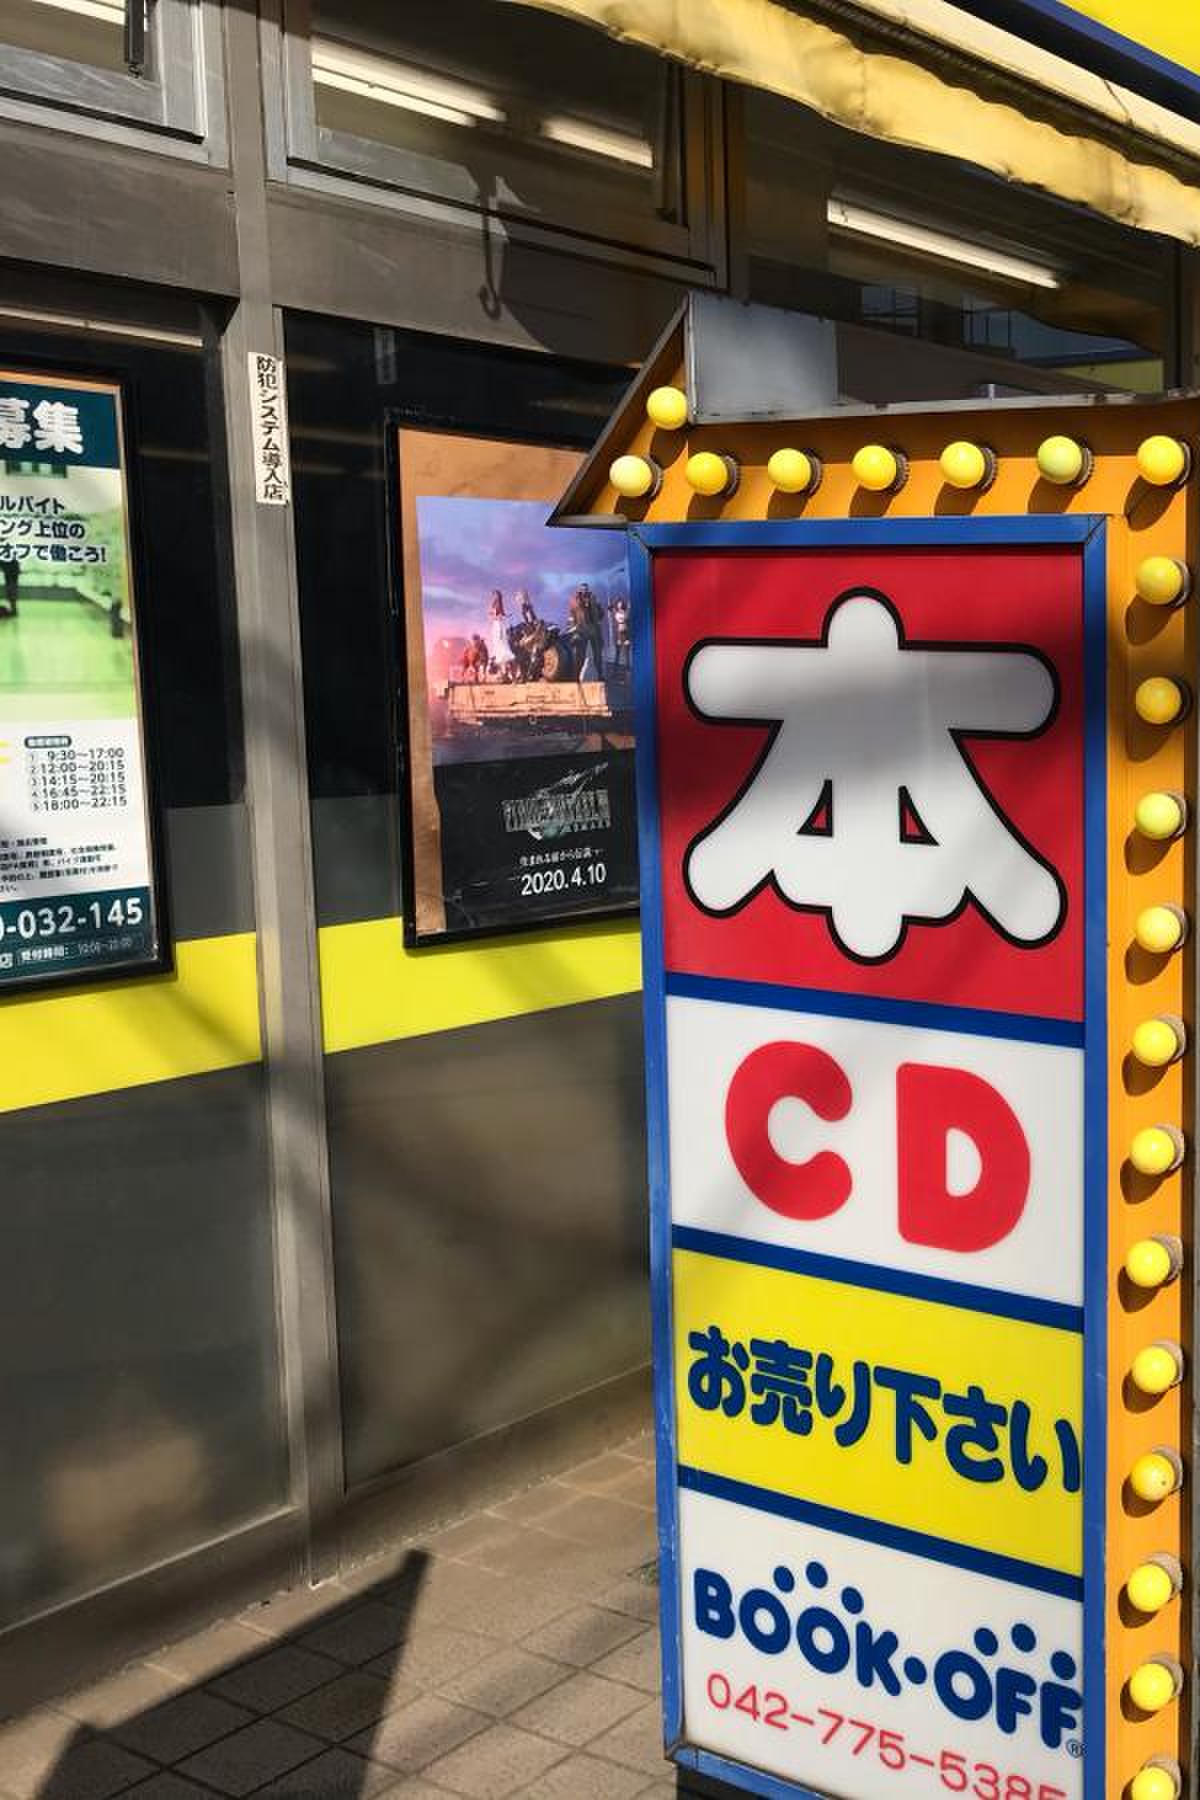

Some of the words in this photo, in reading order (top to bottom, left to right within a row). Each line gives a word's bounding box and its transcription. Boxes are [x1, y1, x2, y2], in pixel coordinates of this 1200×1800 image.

[256, 355, 284, 500] 防犯システム導入店
[683, 586, 1068, 965] 本
[0, 897, 143, 940] -032-145
[521, 863, 607, 896] 2020.4.10
[725, 1040, 1031, 1253] CD
[688, 1326, 1081, 1493] お売り下さい
